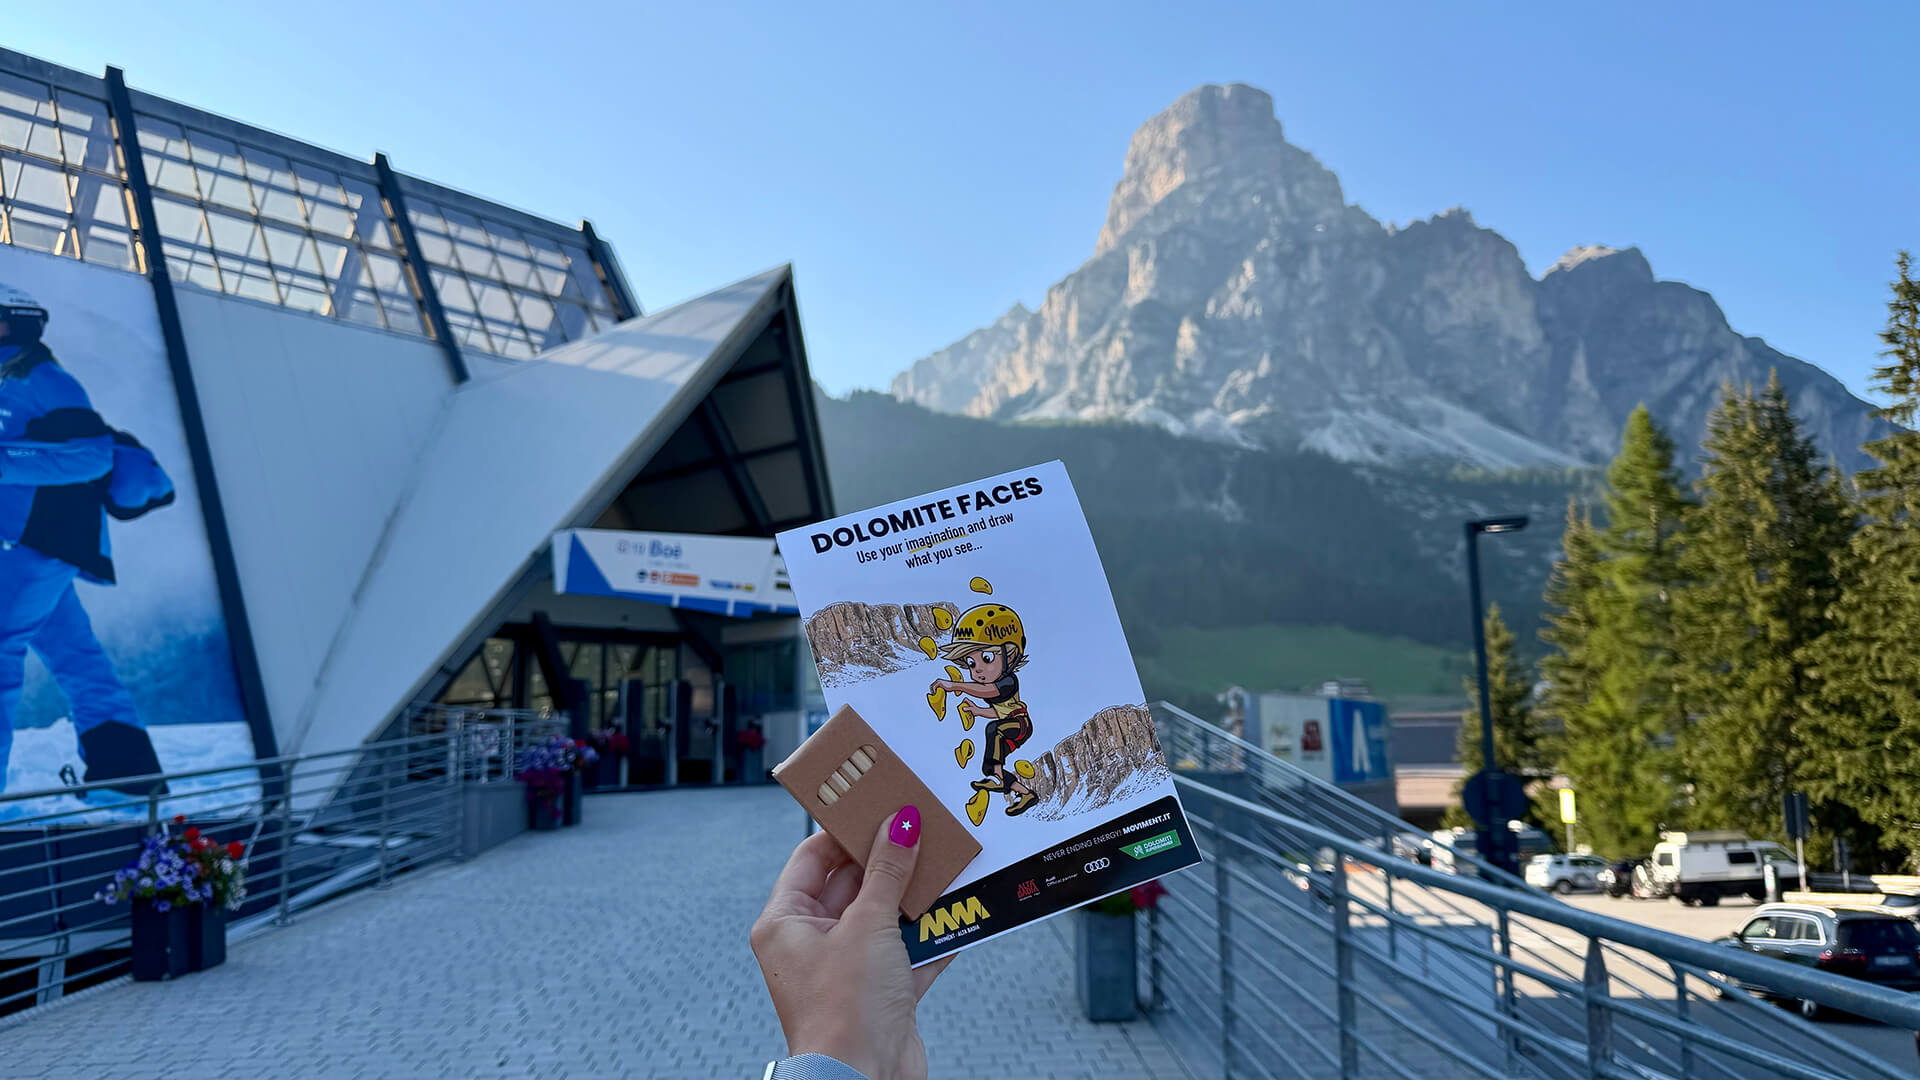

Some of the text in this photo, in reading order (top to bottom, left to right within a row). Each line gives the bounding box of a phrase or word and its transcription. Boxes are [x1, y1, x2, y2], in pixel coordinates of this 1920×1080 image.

[810, 477, 1043, 554] DOLOMITE FACES
[856, 512, 1014, 564] Use your imagination and draw
[905, 541, 983, 569] what you see...
[984, 619, 1018, 641] Movi
[1043, 812, 1171, 862] NEVER ENDING ENERGY! MOVIMENT.IT
